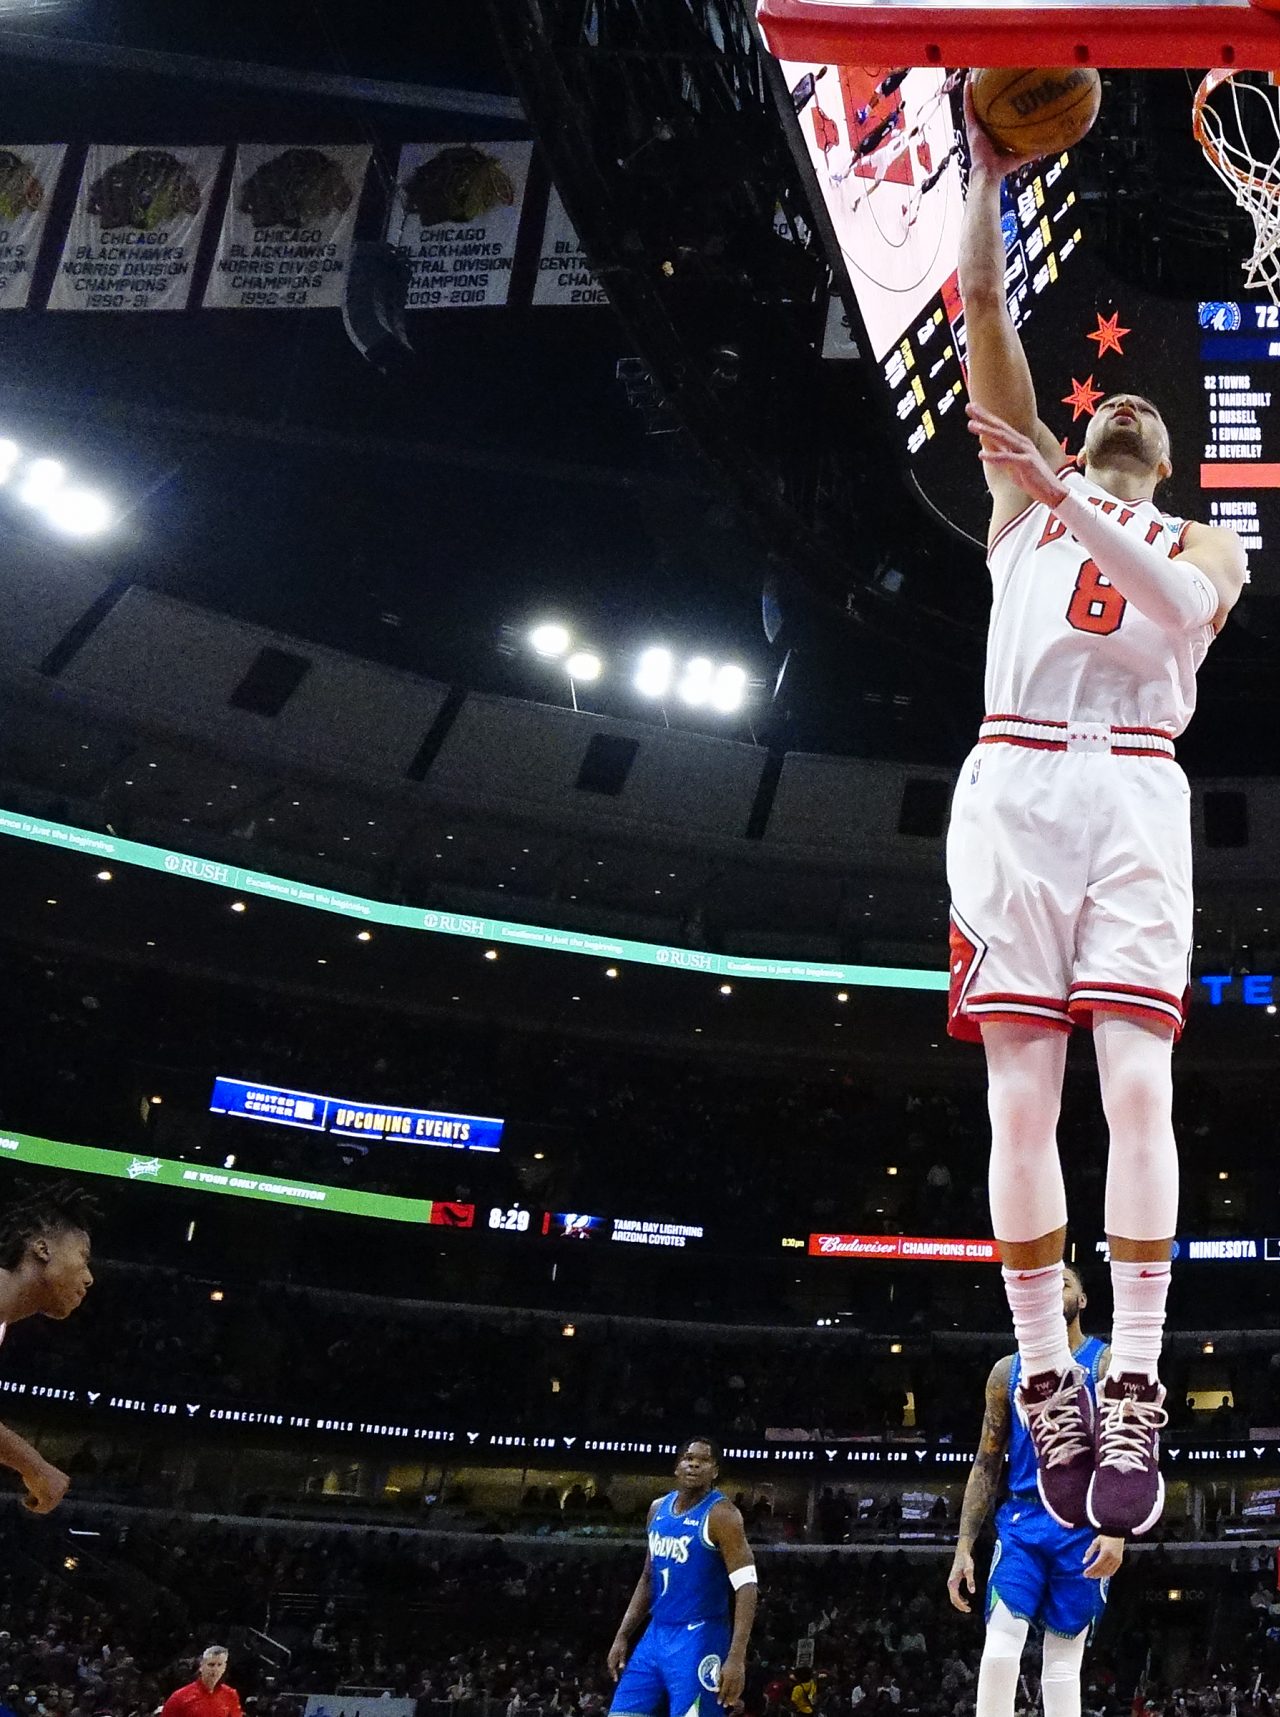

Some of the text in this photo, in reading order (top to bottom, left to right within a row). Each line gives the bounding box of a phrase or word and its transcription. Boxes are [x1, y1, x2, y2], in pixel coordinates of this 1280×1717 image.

[420, 228, 486, 243] CHICAGO
[453, 257, 512, 271] DIVISION
[410, 274, 488, 289] HAMPIONS
[409, 289, 486, 304] 009-2010
[1256, 306, 1279, 328] 72
[1218, 376, 1250, 389] TOWNS
[1205, 445, 1217, 458] 22
[181, 859, 228, 883] RUSH
[440, 915, 484, 935] RUSH
[672, 950, 711, 969] RUSH
[246, 1091, 295, 1108] UNITED
[244, 1101, 294, 1118] CENTER
[336, 1109, 470, 1141] UPCOMING EVENTS
[489, 1208, 530, 1232] 8:29
[614, 1219, 703, 1238] TAMPA BAY LIGHTNING
[611, 1231, 685, 1247] ARIZONA COYOTES
[819, 1236, 993, 1257] Budweiser CHAMPIONS CLUB
[1189, 1241, 1257, 1259] MINNESOTA
[210, 1410, 283, 1425] CONNECTING
[290, 1417, 310, 1428] THE
[659, 1567, 669, 1597] 1
